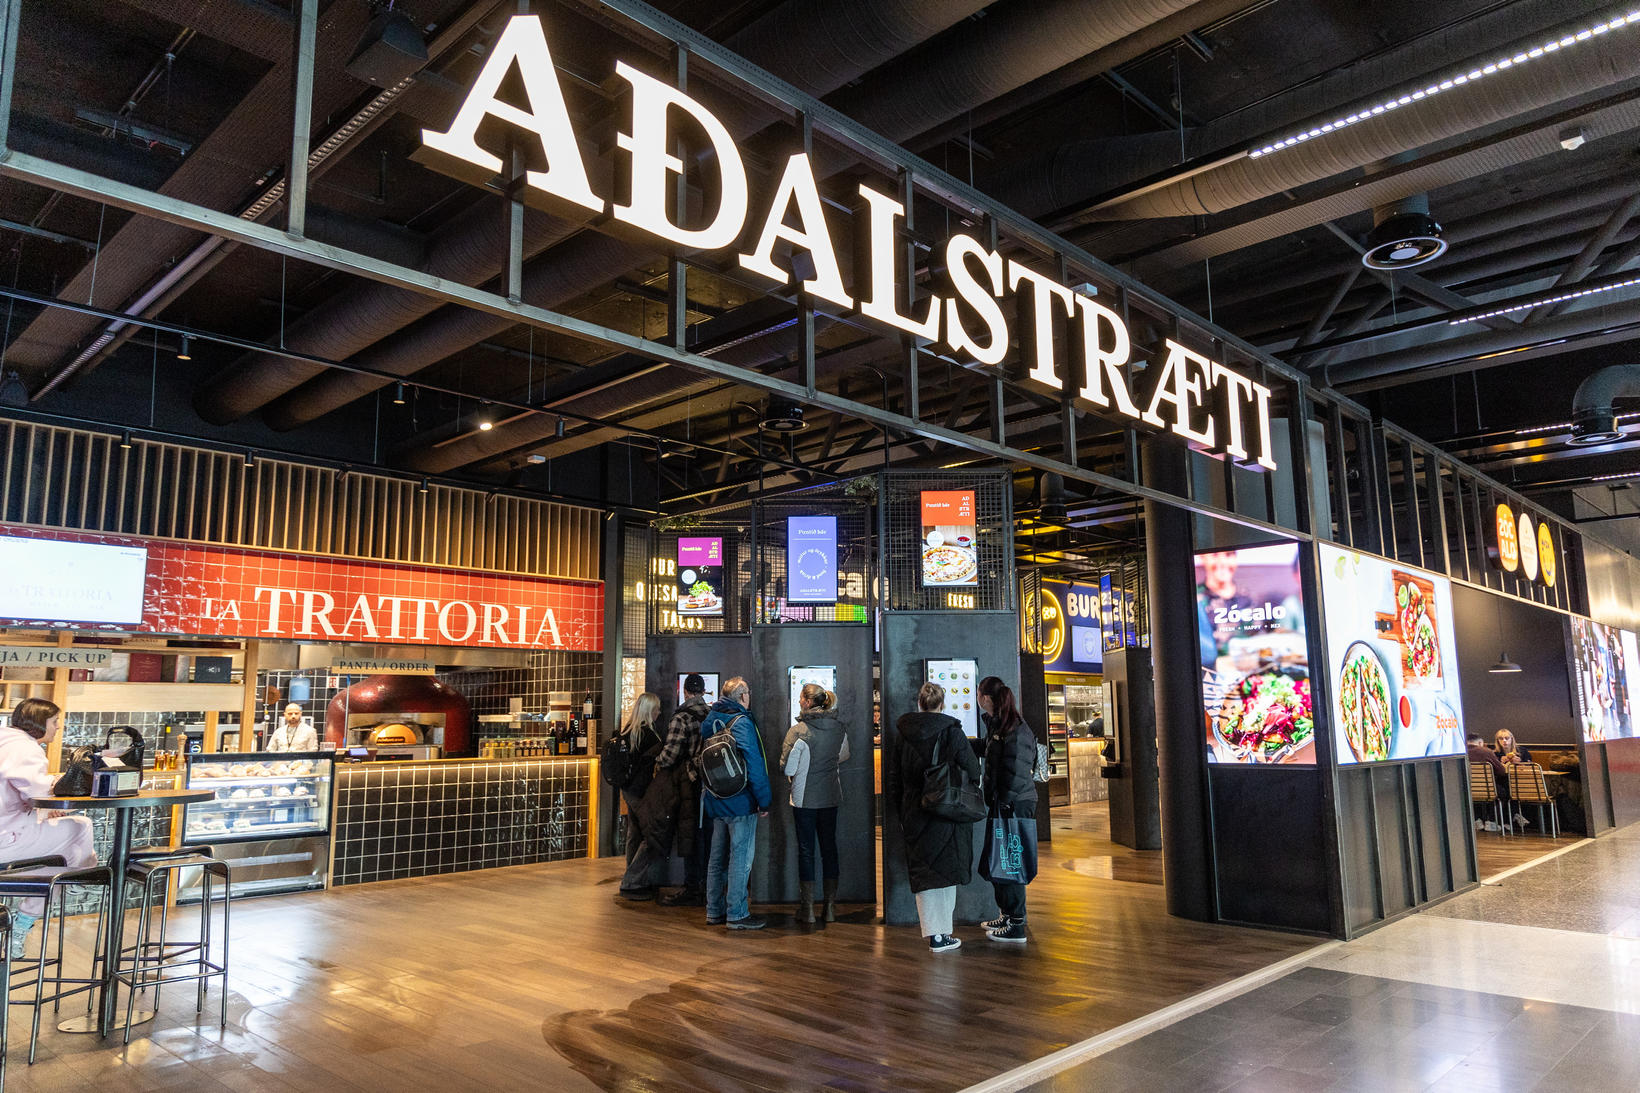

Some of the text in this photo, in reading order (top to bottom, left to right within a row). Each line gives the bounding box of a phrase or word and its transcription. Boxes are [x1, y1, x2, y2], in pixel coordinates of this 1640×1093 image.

[422, 15, 1277, 471] AÐALSTRÆTI
[202, 586, 565, 647] LA TRATTORIA
[1066, 591, 1136, 624] BURES
[1213, 602, 1287, 624] Zócalo
[0, 651, 19, 663] JA
[38, 652, 79, 663] PICK
[86, 653, 107, 664] UP
[339, 660, 378, 671] PANTA
[389, 662, 430, 672] ORDER
